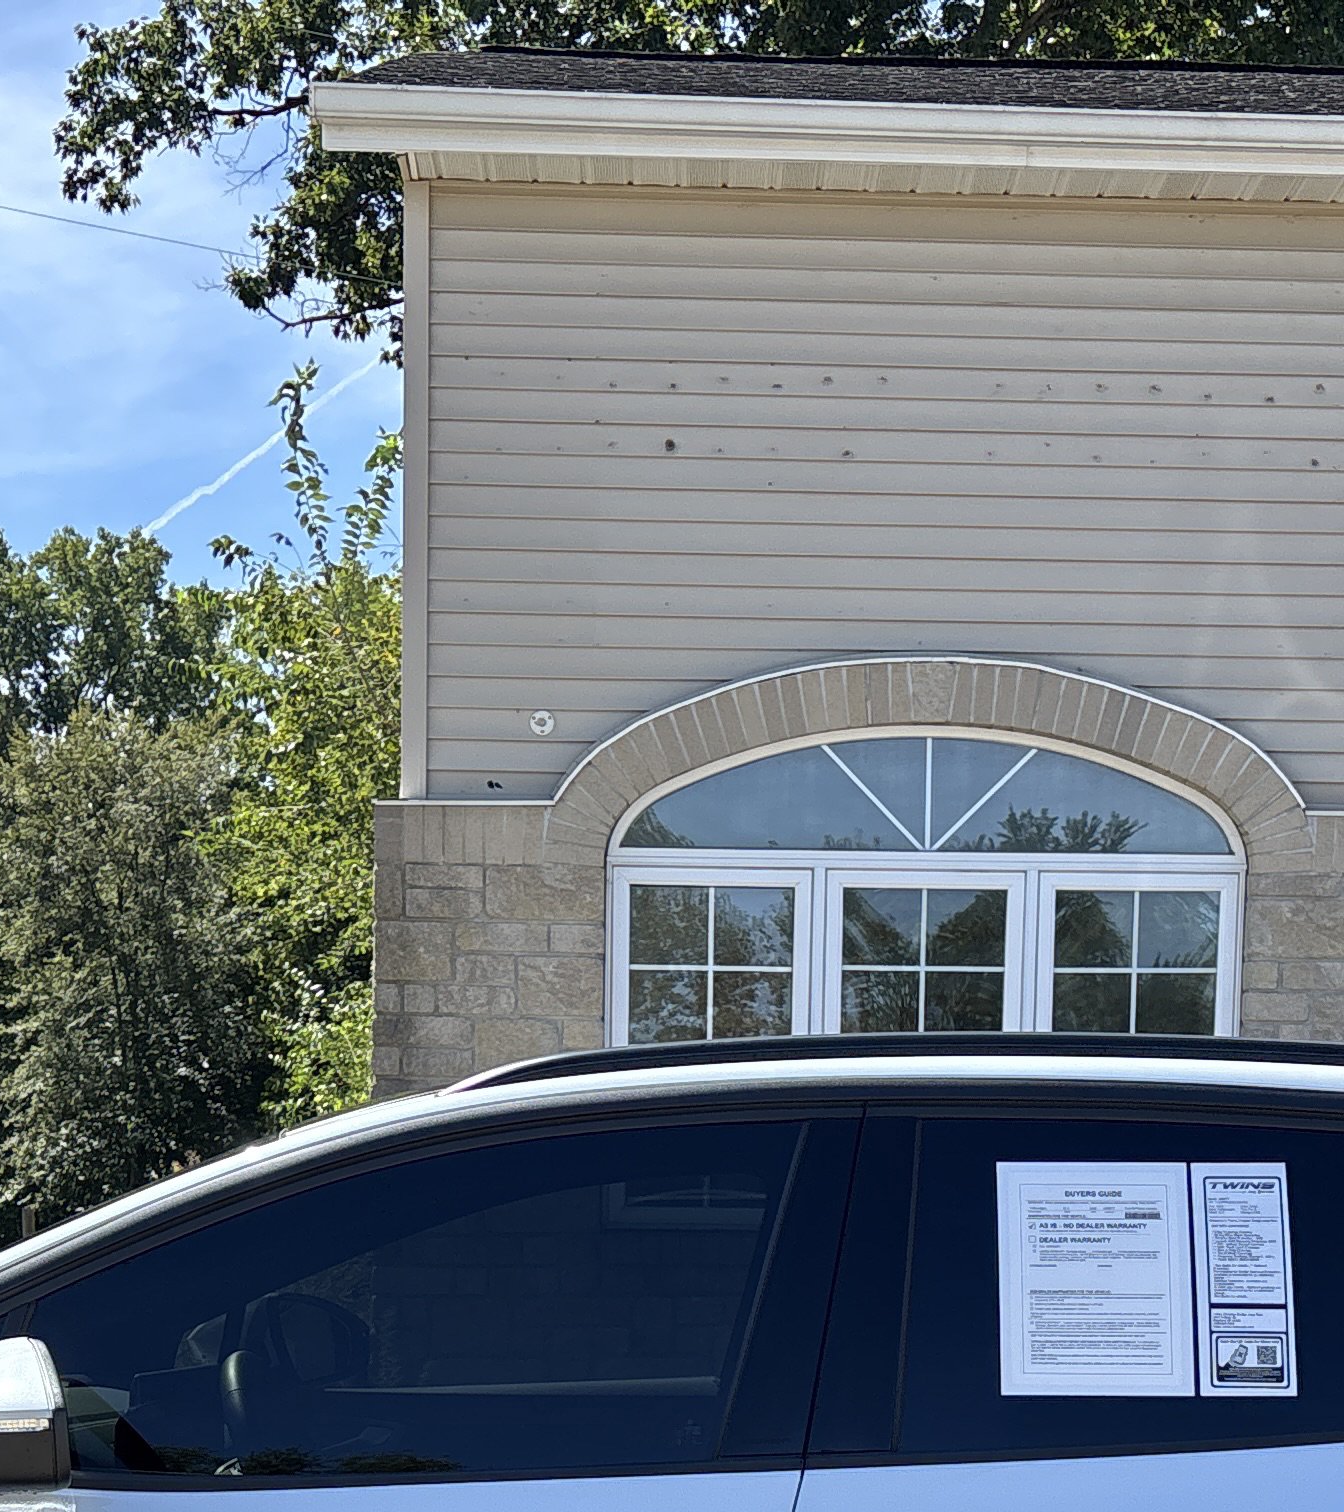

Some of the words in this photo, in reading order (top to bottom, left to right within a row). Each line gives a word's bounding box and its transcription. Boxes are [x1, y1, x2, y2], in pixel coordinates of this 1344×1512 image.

[1208, 1181, 1276, 1190] TWINS
[1064, 1190, 1096, 1198] BUYERS
[1098, 1190, 1123, 1198] GUIDE
